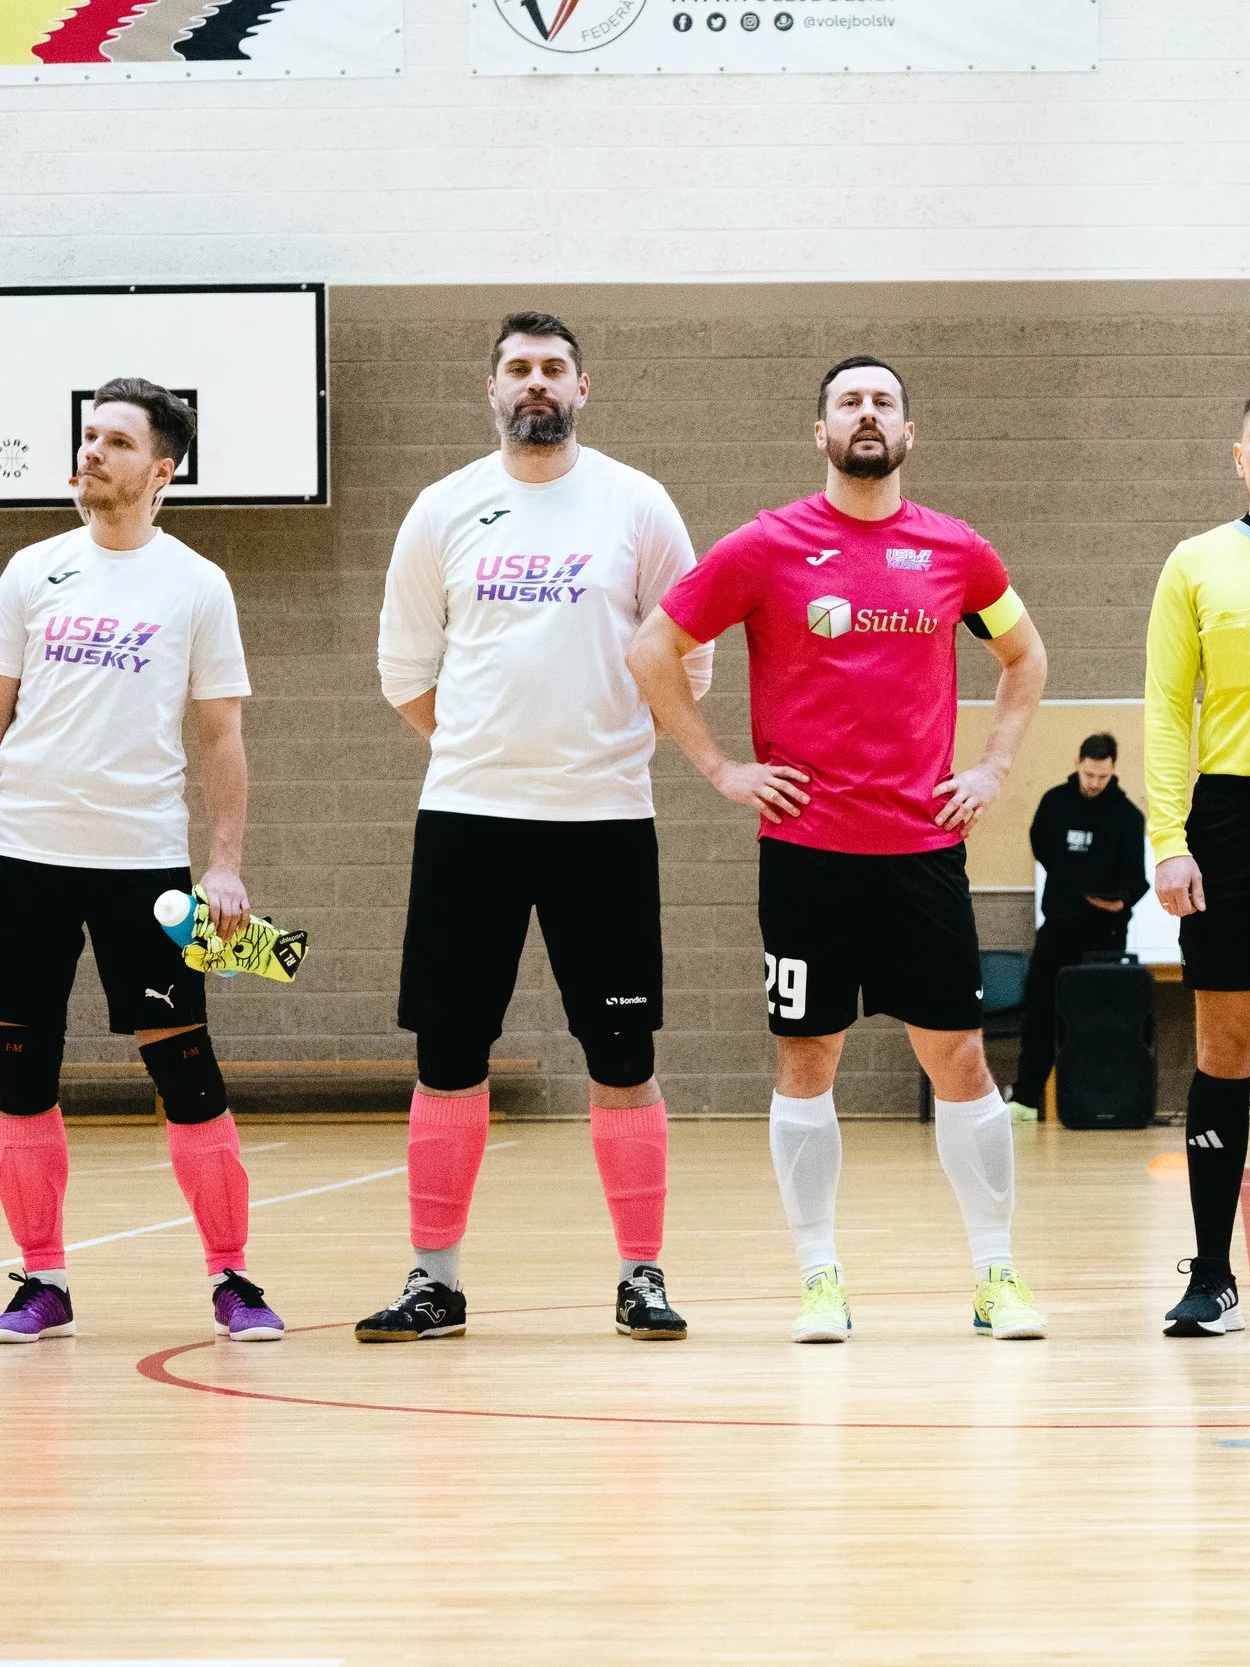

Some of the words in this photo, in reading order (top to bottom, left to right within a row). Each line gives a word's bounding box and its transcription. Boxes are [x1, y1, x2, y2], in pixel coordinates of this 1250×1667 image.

[803, 14, 896, 30] @volejbolslv
[885, 548, 917, 561] USB
[475, 554, 551, 581] USB
[476, 584, 588, 603] HUSKY
[44, 615, 120, 643] USB
[854, 608, 938, 634] Sūti.lv
[44, 644, 151, 673] HUSKY
[619, 996, 647, 1005] Sondico
